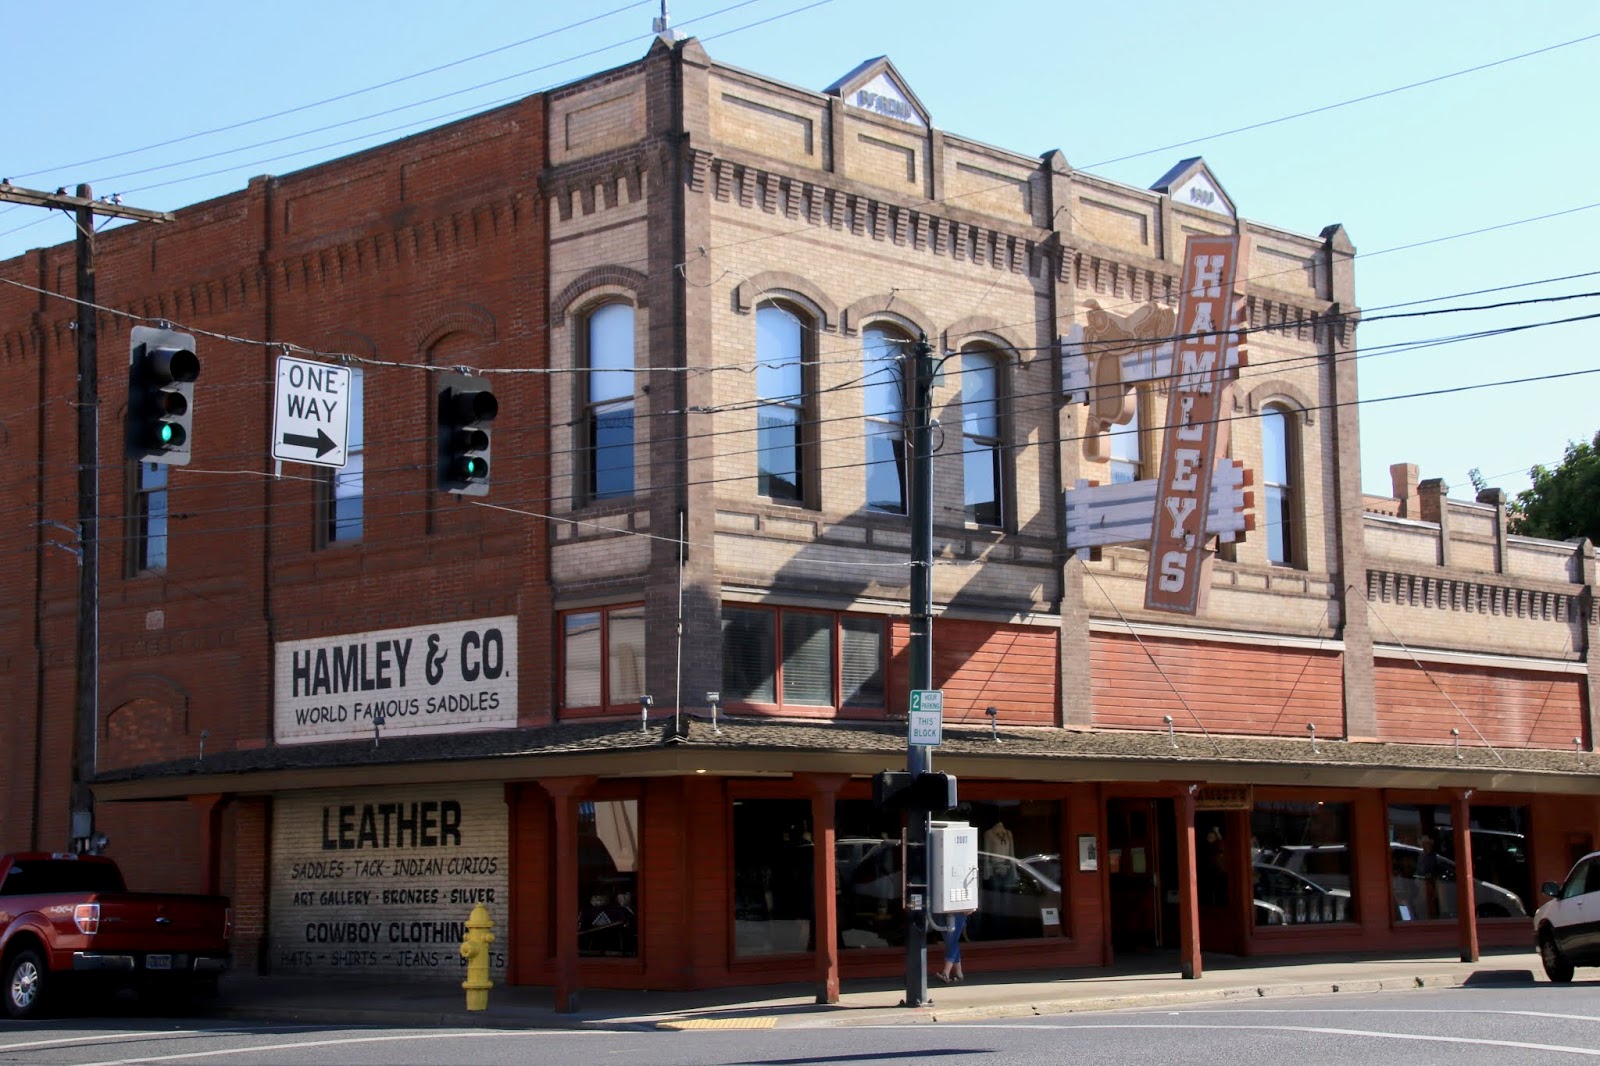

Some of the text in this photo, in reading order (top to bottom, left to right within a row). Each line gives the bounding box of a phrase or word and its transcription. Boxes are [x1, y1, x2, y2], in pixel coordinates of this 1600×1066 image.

[289, 364, 338, 394] ONE
[288, 394, 337, 423] WAY
[292, 628, 509, 697] HAMLEY & CO.
[295, 692, 500, 725] WORLD FAMOUS SADDLES
[912, 693, 938, 709] 2 HOUR
[919, 717, 933, 726] THIS
[913, 729, 937, 737] BLOCK
[321, 800, 462, 850] LEATHER
[291, 860, 344, 879] SADDLES
[355, 860, 384, 877] TACK
[392, 858, 444, 877] INDIAN
[447, 856, 498, 876] CURIOS
[293, 893, 315, 906] ART
[320, 890, 371, 906] GALLERY
[382, 888, 439, 904] BRONZES
[450, 888, 496, 904] SILVER
[306, 922, 469, 944] COWBOY CLOTHIN
[281, 952, 313, 967] HATS
[331, 951, 377, 966] SHIRTS
[396, 951, 439, 967] JEANS
[460, 953, 504, 967] BTS
